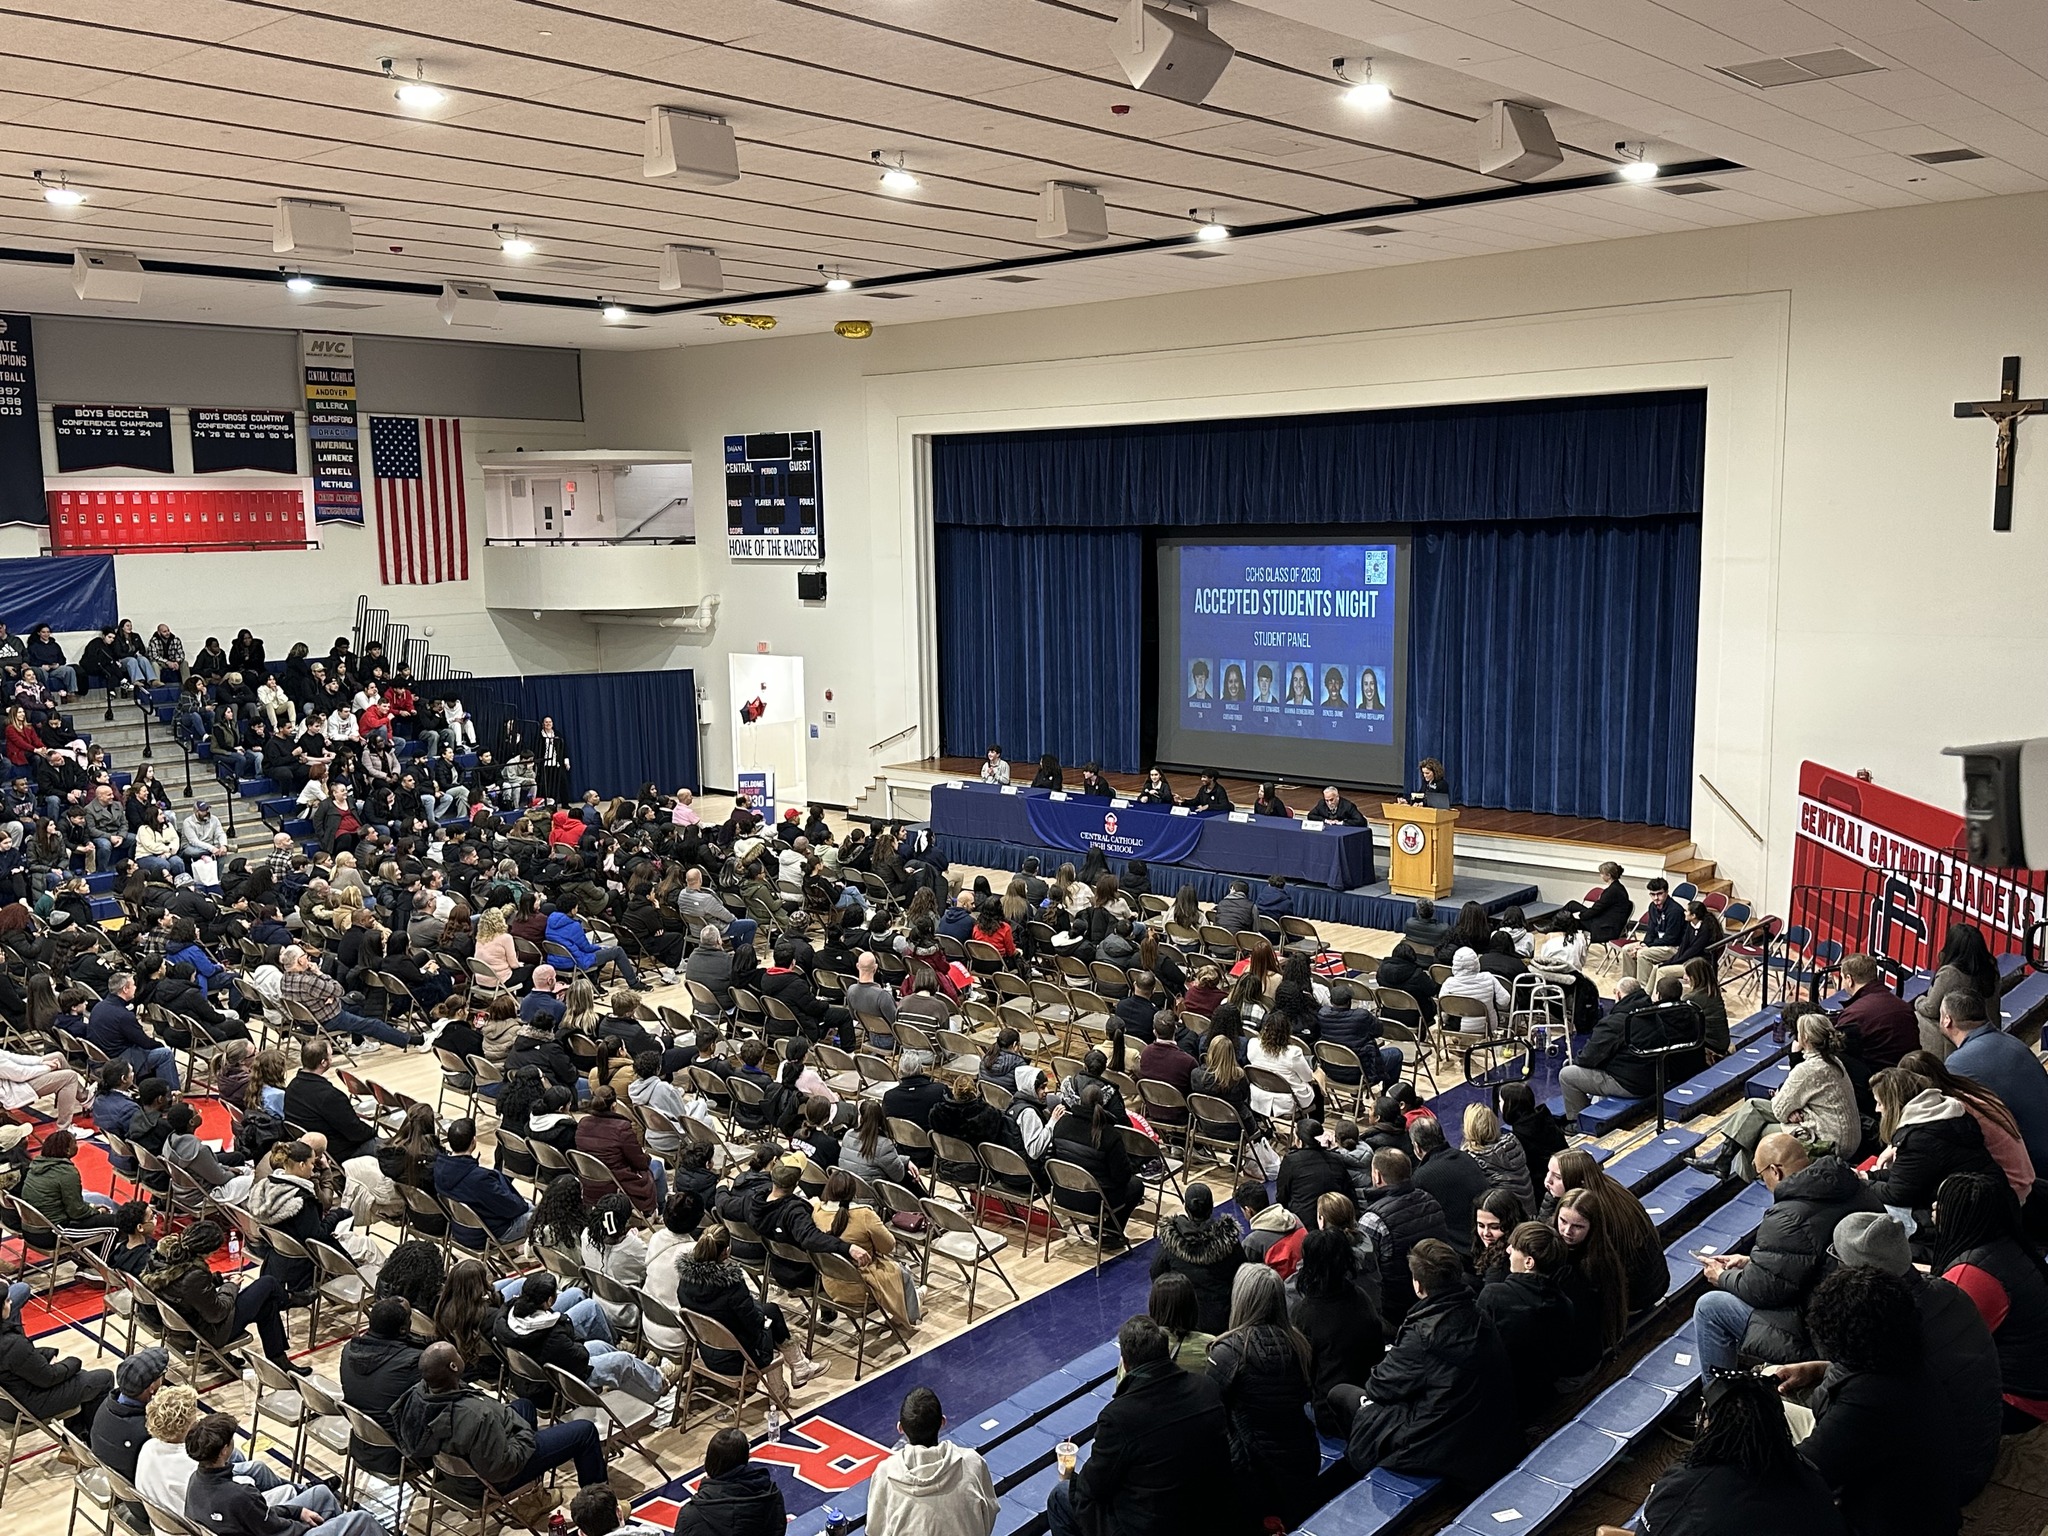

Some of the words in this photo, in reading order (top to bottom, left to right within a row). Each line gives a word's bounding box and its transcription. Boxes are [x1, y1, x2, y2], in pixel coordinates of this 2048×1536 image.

[311, 340, 346, 353] MVC
[0, 354, 27, 367] PIONS
[308, 370, 330, 382] CENTRAL
[331, 371, 353, 382] CATHOLIC
[316, 402, 348, 410] BILLERICA
[75, 409, 104, 417] BOYS
[107, 410, 149, 419] SOCCER
[250, 414, 284, 422] COUNTRY
[312, 415, 353, 424] CHELMSFORD
[318, 428, 349, 436] DRACUT
[315, 441, 354, 450] HAVERHILL
[318, 454, 353, 462] LAWRENCE
[320, 467, 352, 476] LOWELL
[725, 462, 754, 473] CENTRAL
[789, 460, 811, 471] GUEST
[799, 498, 814, 506] FOULS
[729, 539, 752, 556] HOME
[754, 539, 764, 556] OF
[767, 539, 781, 556] THE
[784, 539, 817, 556] RAIDERS
[1246, 567, 1264, 582] CCHS
[1265, 567, 1288, 582] CLASS
[1290, 568, 1299, 582] OF
[1301, 567, 1321, 583] 2030
[1194, 588, 1260, 615] ACCEPTED
[1263, 589, 1332, 617] STUDENTS
[1335, 590, 1379, 618] NIGHT
[1254, 631, 1286, 647] STUDENT
[1288, 632, 1311, 648] PANEL
[1080, 832, 1110, 842] CENTRAL
[1111, 836, 1143, 846] CATHOLIC
[1107, 844, 1134, 854] SCHOOL
[1801, 802, 1864, 857] CENTRAL
[1869, 831, 1944, 892] CATHOLIC
[1952, 866, 2036, 931] RAIDERS
